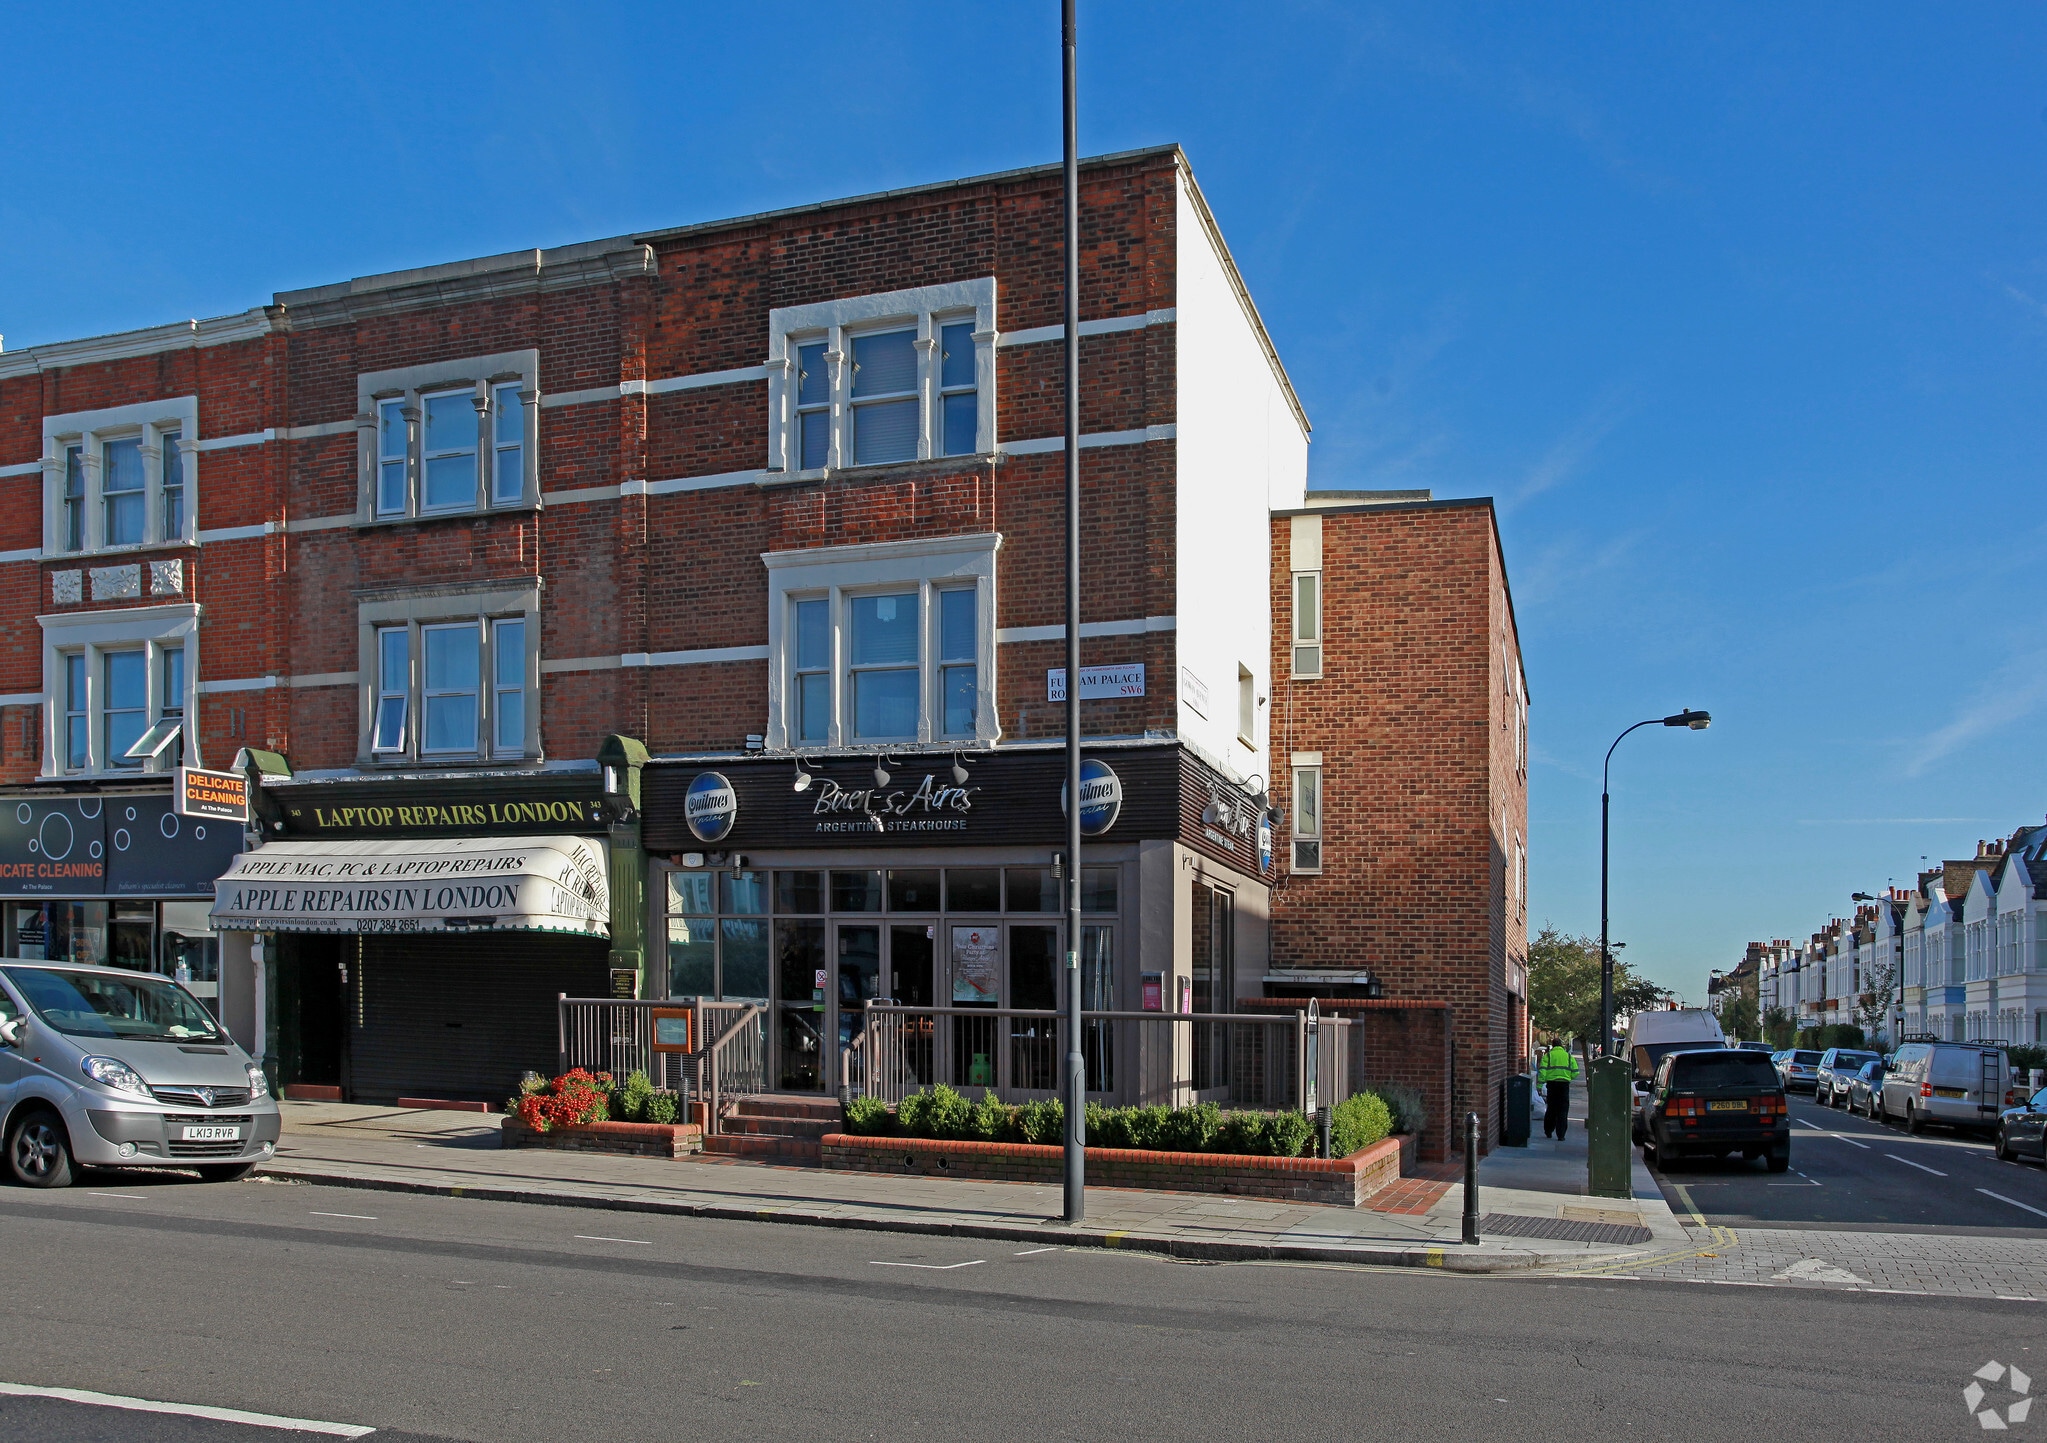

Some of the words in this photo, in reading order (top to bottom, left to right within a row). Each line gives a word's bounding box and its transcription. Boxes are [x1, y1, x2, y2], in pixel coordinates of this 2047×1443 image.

[1051, 675, 1097, 687] FUAM
[1101, 673, 1142, 684] PALACE
[1120, 686, 1142, 695] SW6
[188, 774, 244, 792] DELICATE
[187, 788, 246, 806] CLEANING
[688, 793, 729, 815] Quilmes
[314, 806, 394, 827] LAPTOP
[396, 804, 487, 827] REPAIRS
[489, 801, 584, 823] LONDON
[590, 801, 601, 809] 343
[816, 822, 882, 833] ARGENTIN
[888, 819, 967, 831] STEAKHOUSE
[234, 862, 292, 875] APPLE
[289, 862, 334, 877] MAC,
[336, 863, 364, 876] PC
[362, 863, 378, 876] &
[379, 861, 451, 875] LAPTOP
[449, 856, 527, 872] REPAIRS
[568, 845, 593, 871] MAC
[38, 863, 103, 878] CLEANING
[559, 864, 576, 886] PC
[571, 875, 604, 910] REPAIRS
[230, 889, 298, 911] APPLE
[300, 889, 392, 911] REPAIRS
[392, 889, 418, 911] IN
[421, 884, 520, 911] LONDON
[357, 919, 377, 931] 0207
[380, 919, 397, 930] 384
[398, 919, 420, 930] 2651
[1711, 1101, 1731, 1109] P260
[1732, 1101, 1746, 1109] DBL
[189, 1128, 213, 1138] LK13
[214, 1128, 234, 1138] RVR
